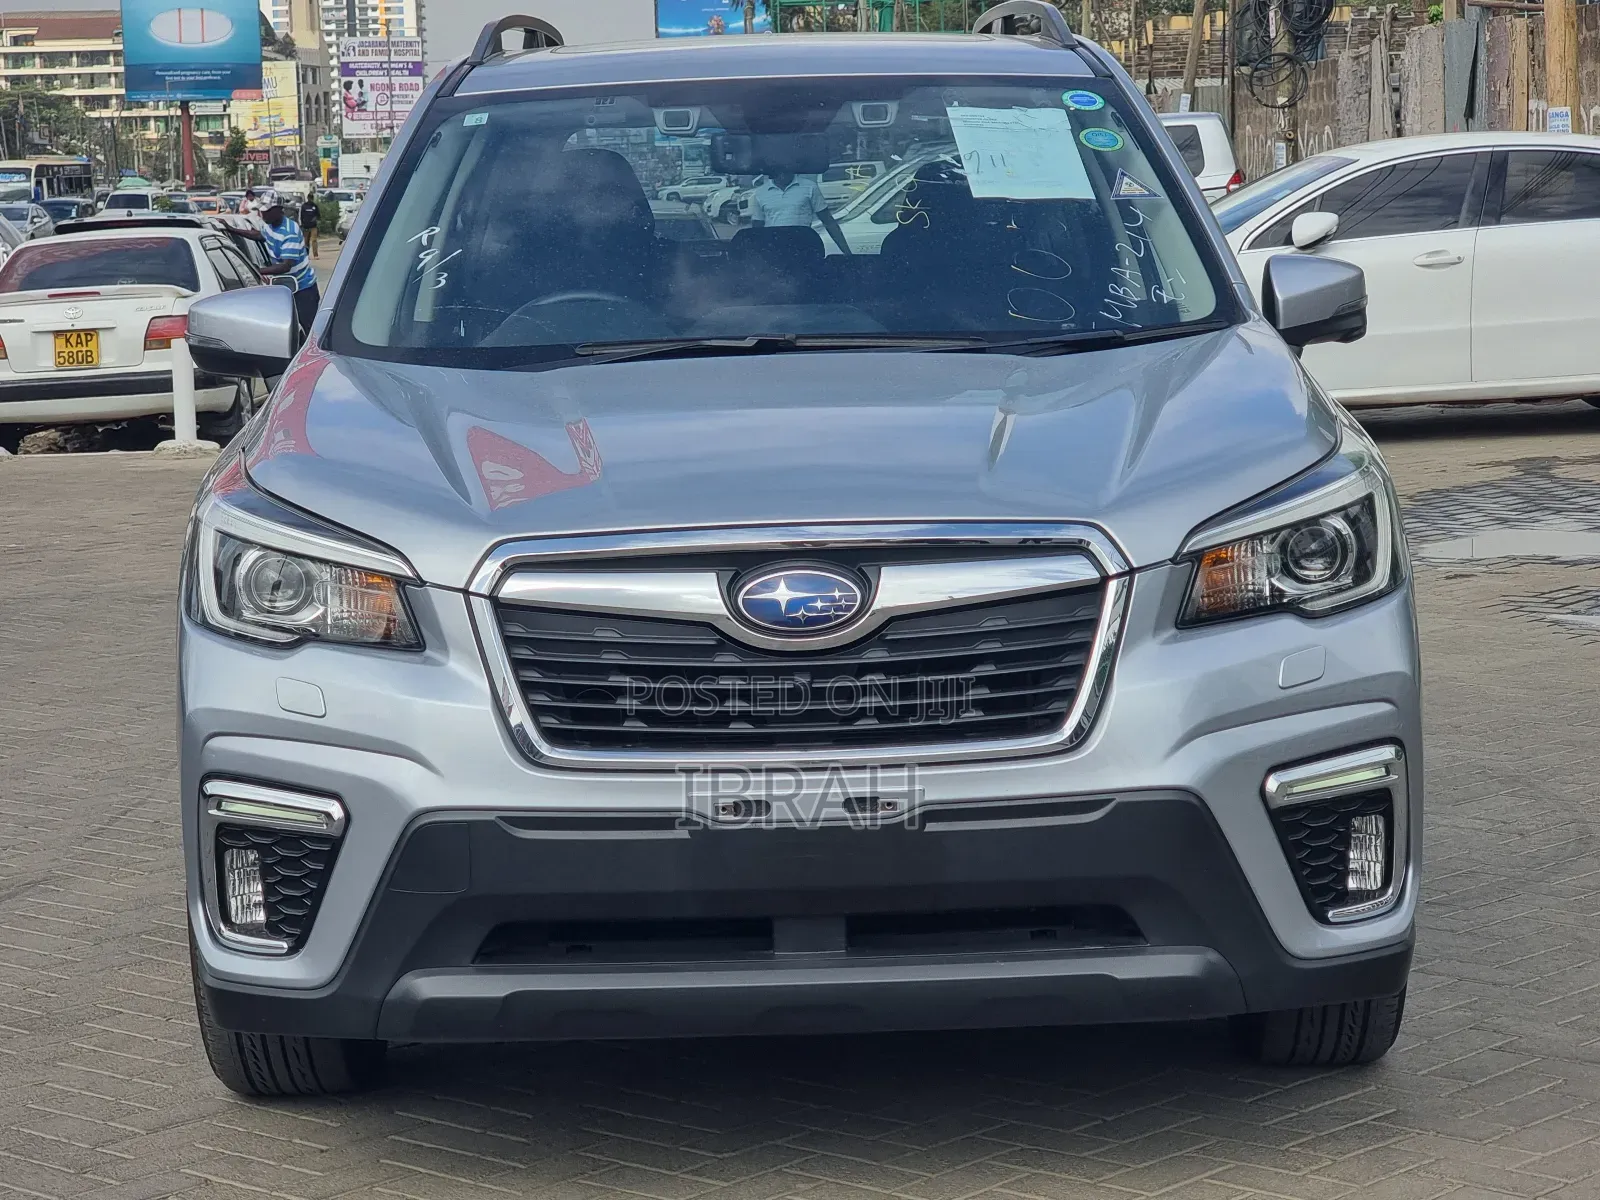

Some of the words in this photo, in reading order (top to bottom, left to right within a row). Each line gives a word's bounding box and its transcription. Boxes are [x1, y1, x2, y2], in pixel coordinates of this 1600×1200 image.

[391, 40, 420, 48] MATERNITY
[357, 48, 370, 57] AND
[393, 48, 420, 57] HOSPITAL
[369, 83, 397, 92] NGONG
[398, 83, 420, 92] ROAD
[64, 332, 94, 349] KAP
